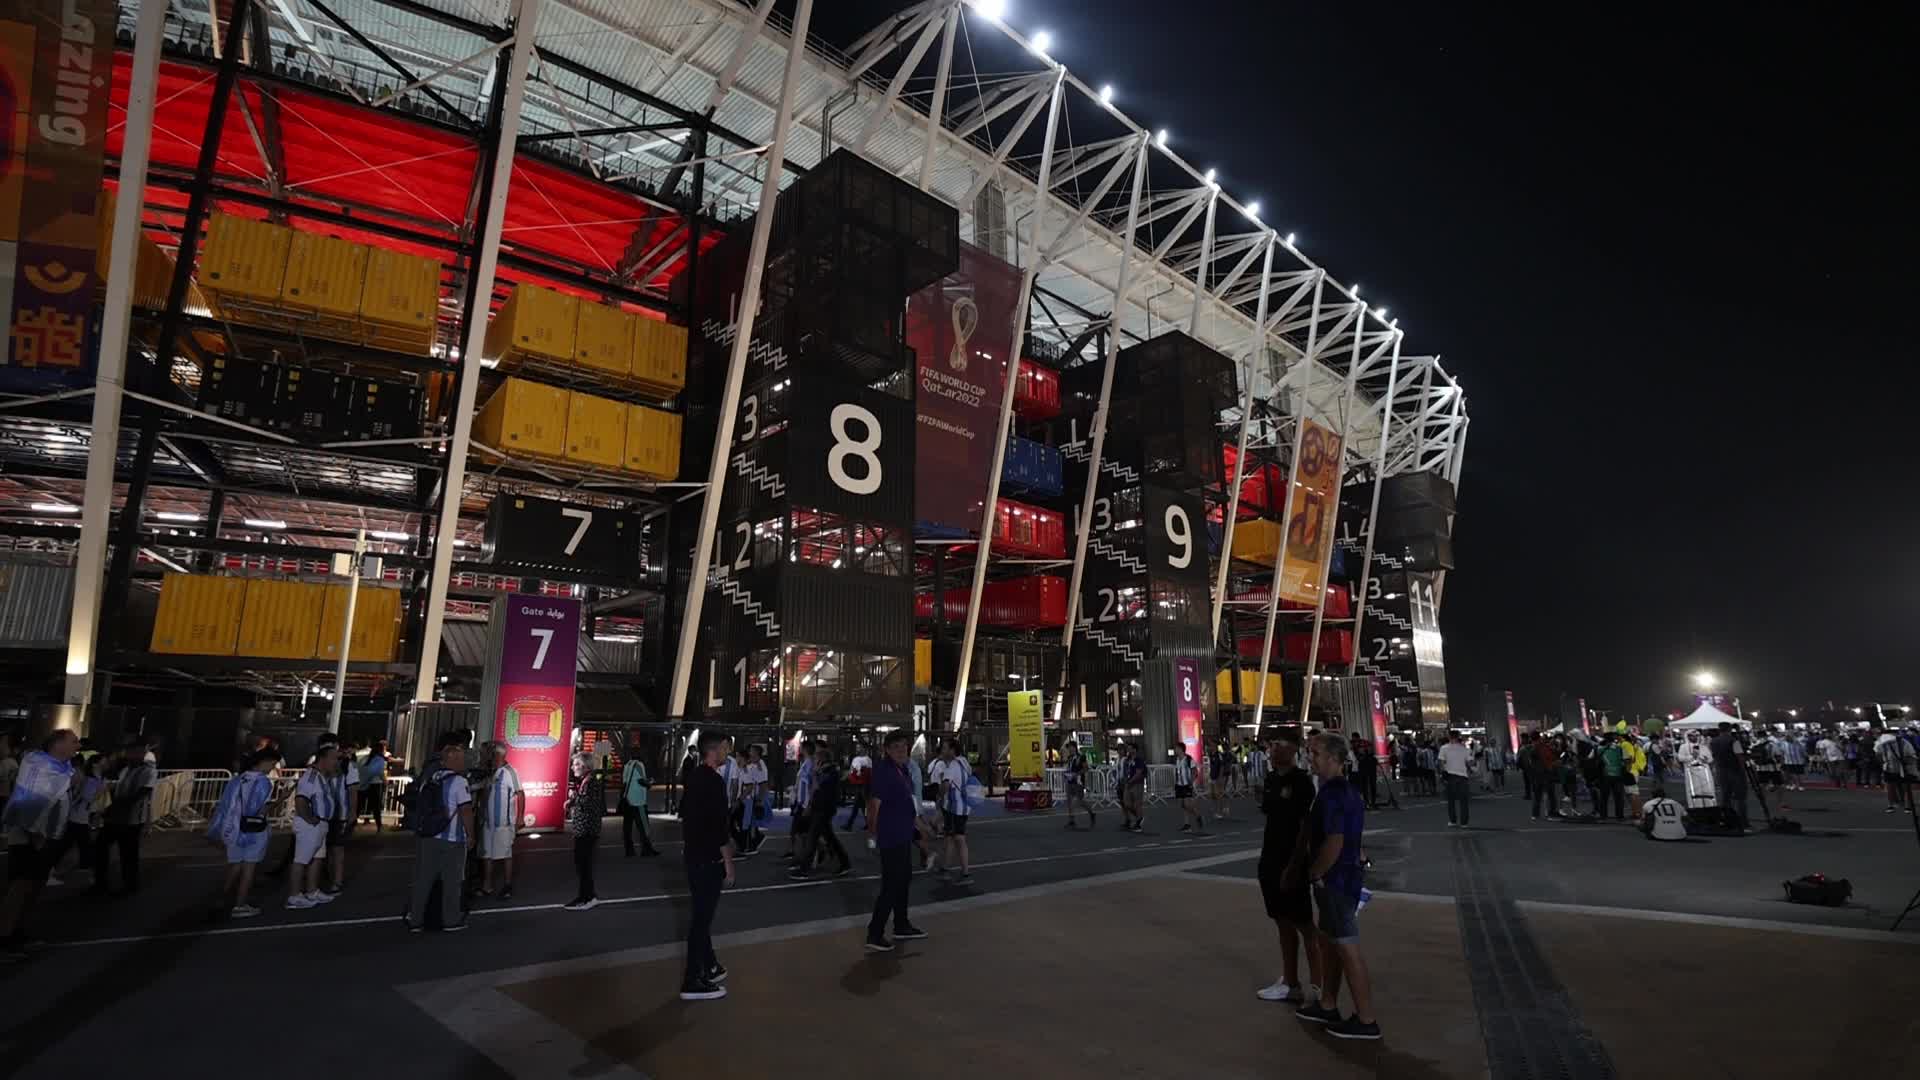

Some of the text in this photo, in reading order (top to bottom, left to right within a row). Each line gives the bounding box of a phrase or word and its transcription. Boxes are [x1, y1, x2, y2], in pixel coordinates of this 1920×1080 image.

[39, 0, 104, 146] azing
[919, 365, 987, 397] FIFA WORLD CUP
[916, 413, 975, 440] #FIFAWorldCup
[827, 402, 882, 495] 8
[562, 507, 592, 556] 7
[1164, 504, 1192, 569] 9
[521, 606, 544, 616] Gate
[1411, 580, 1437, 628] 11
[530, 628, 555, 670] 7
[1183, 677, 1193, 703] 8
[1374, 690, 1381, 709] 9
[544, 781, 558, 789] CUP
